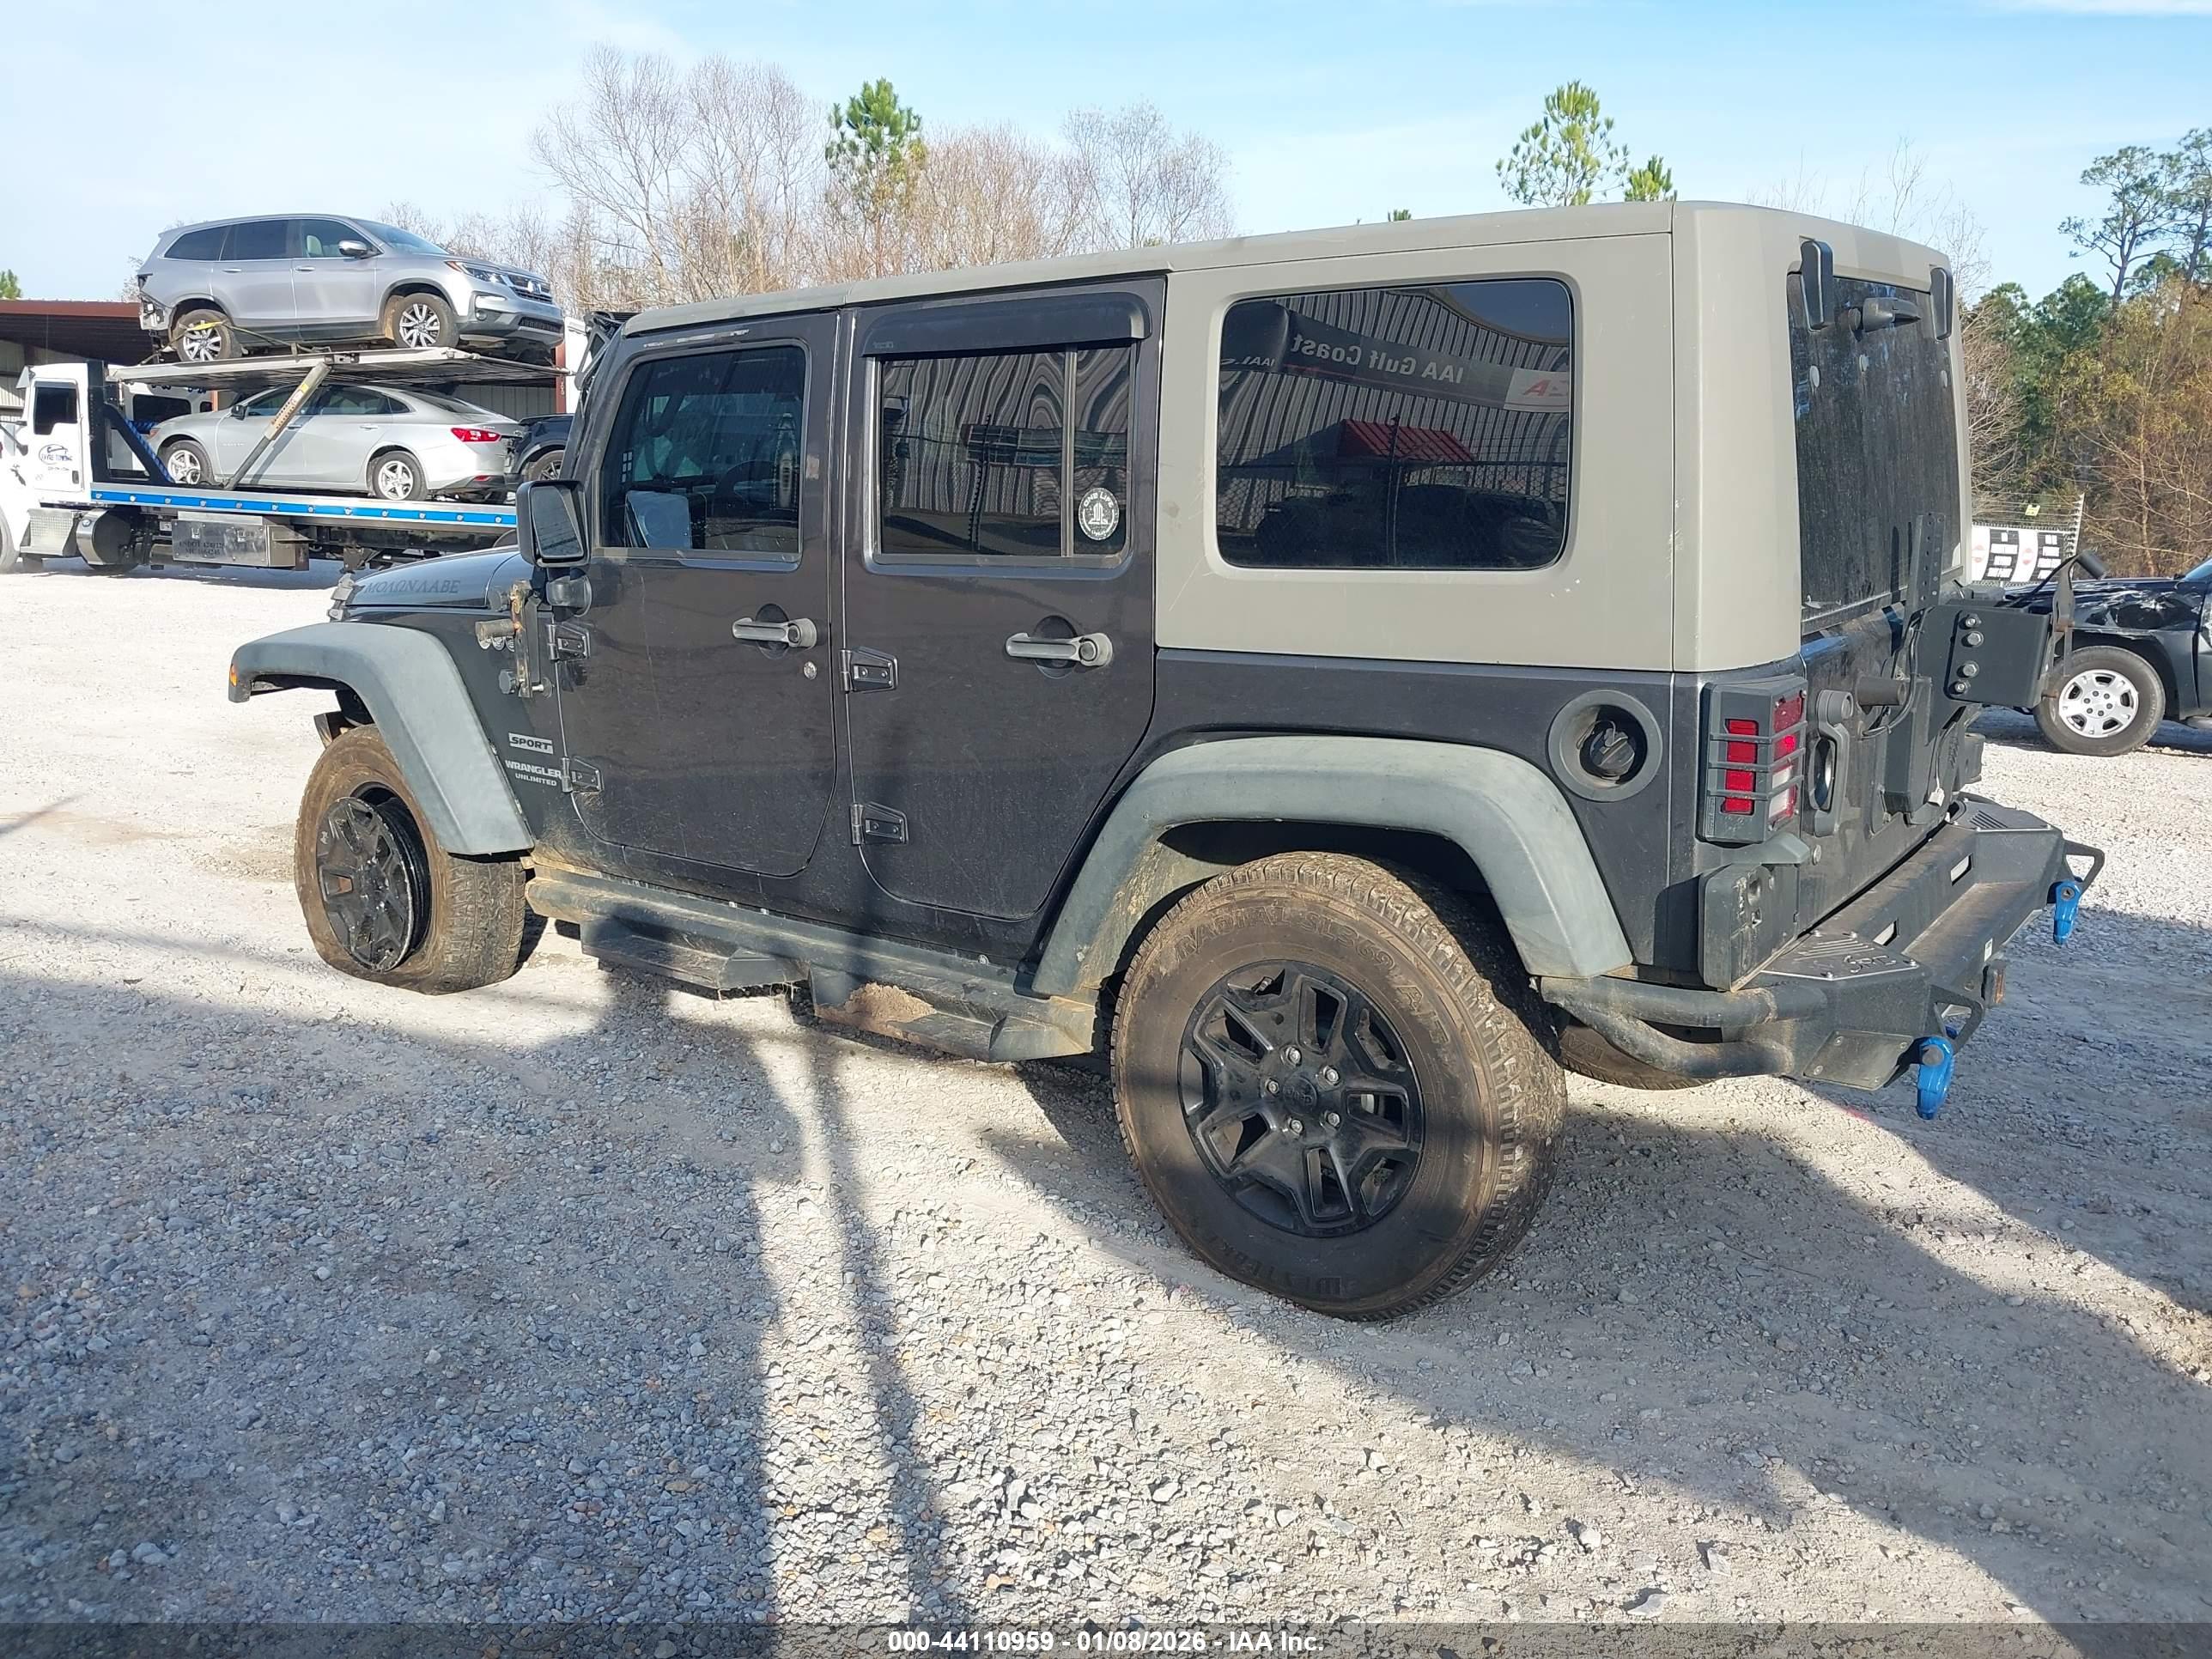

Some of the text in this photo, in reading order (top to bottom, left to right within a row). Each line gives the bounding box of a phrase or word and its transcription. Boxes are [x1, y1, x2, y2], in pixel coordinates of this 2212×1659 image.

[1083, 492, 1099, 507] ONE
[511, 736, 553, 750] SPORT
[505, 759, 562, 779] WRANGLER
[514, 772, 557, 787] UNLIMITED
[1174, 905, 1291, 961] RADIAL
[1299, 910, 1396, 970] SL369
